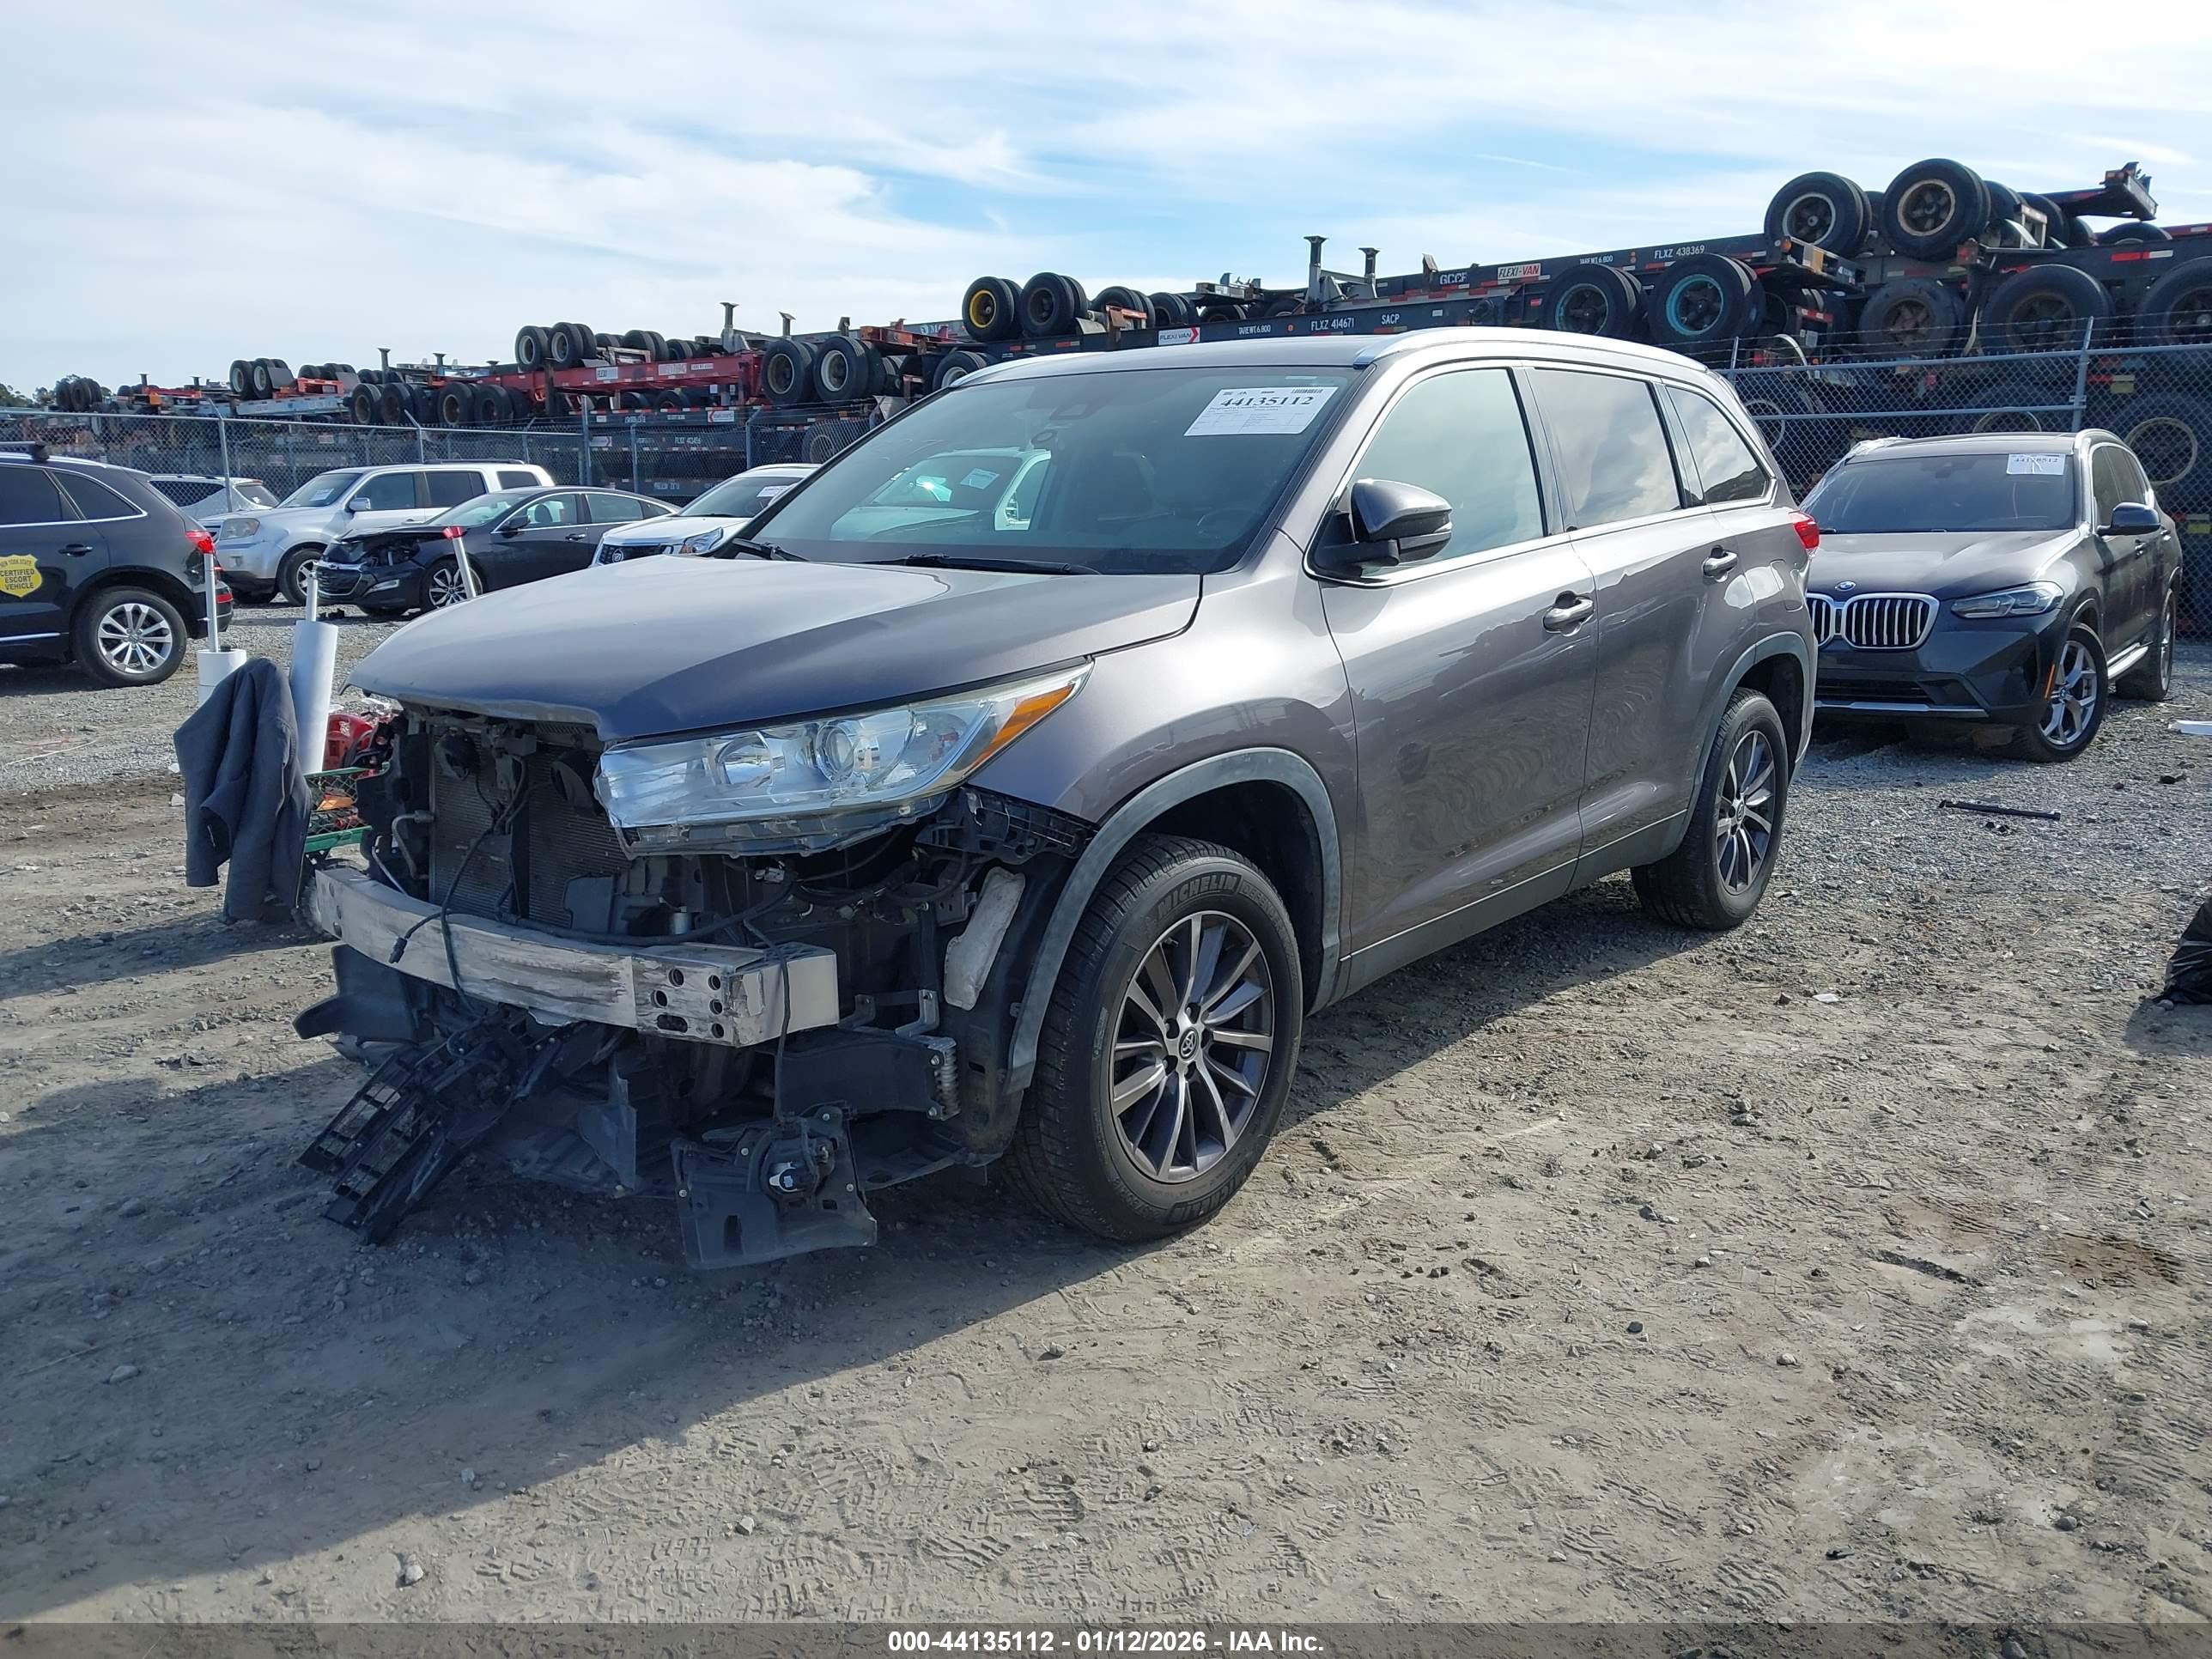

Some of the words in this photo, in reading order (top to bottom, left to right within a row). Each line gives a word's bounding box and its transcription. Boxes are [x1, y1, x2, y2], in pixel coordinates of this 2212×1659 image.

[1654, 248, 1674, 259] FLXZ
[1675, 244, 1705, 257] 438369
[1498, 264, 1540, 277] FLEXI-VAN
[1310, 319, 1329, 331] FLXZ
[1331, 317, 1354, 329] 414671
[1381, 313, 1400, 325] SACP
[1220, 396, 1315, 407] 44135112
[1157, 874, 1237, 921] MICHELIN
